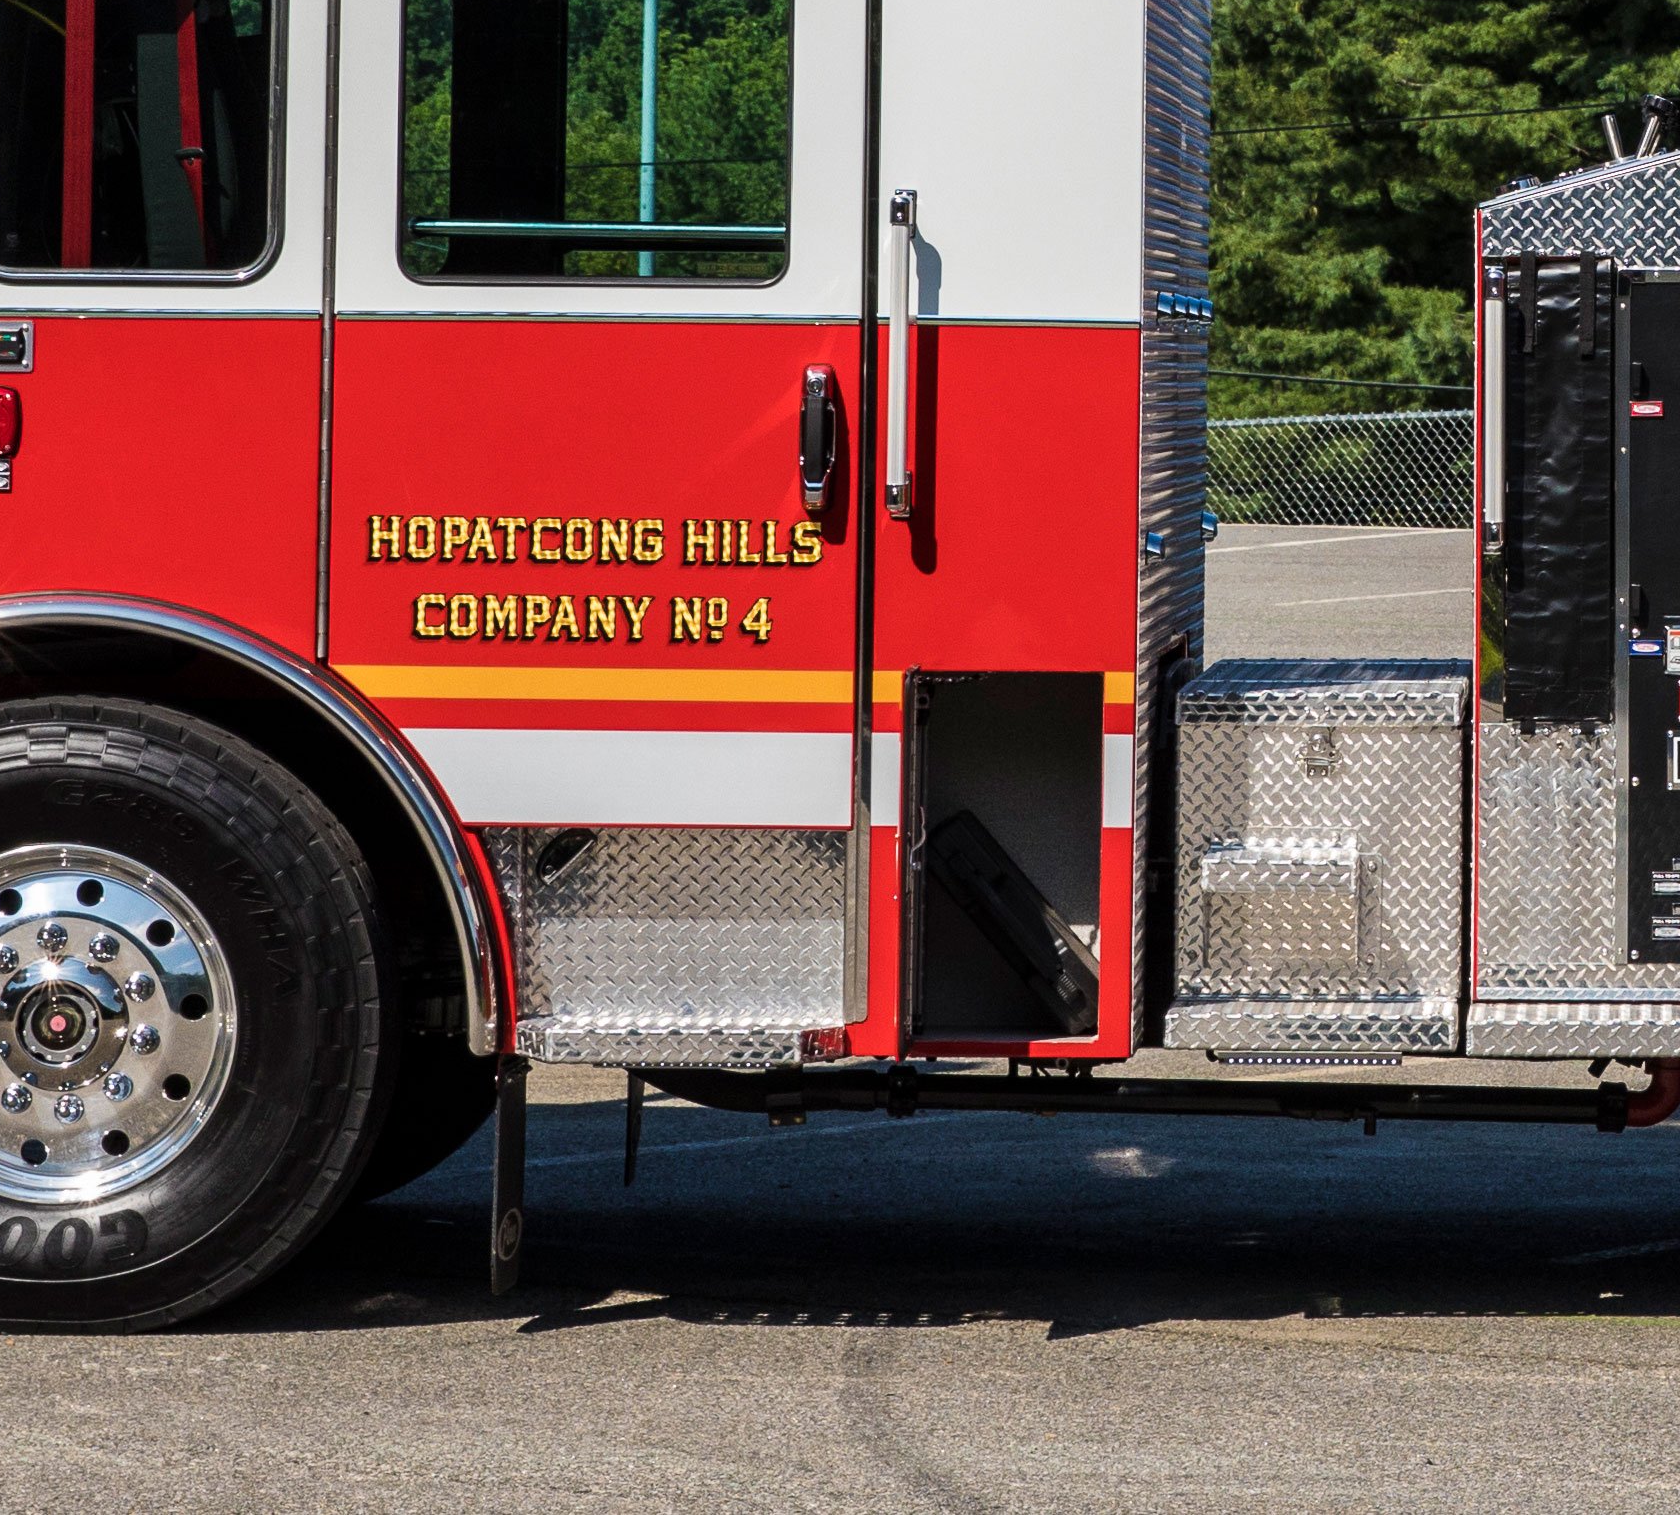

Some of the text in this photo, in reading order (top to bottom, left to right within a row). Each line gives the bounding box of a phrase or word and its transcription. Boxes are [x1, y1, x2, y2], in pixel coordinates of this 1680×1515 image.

[368, 514, 826, 567] HOPATCONG HILLS
[412, 593, 654, 642] COMPANY
[741, 597, 773, 644] 4
